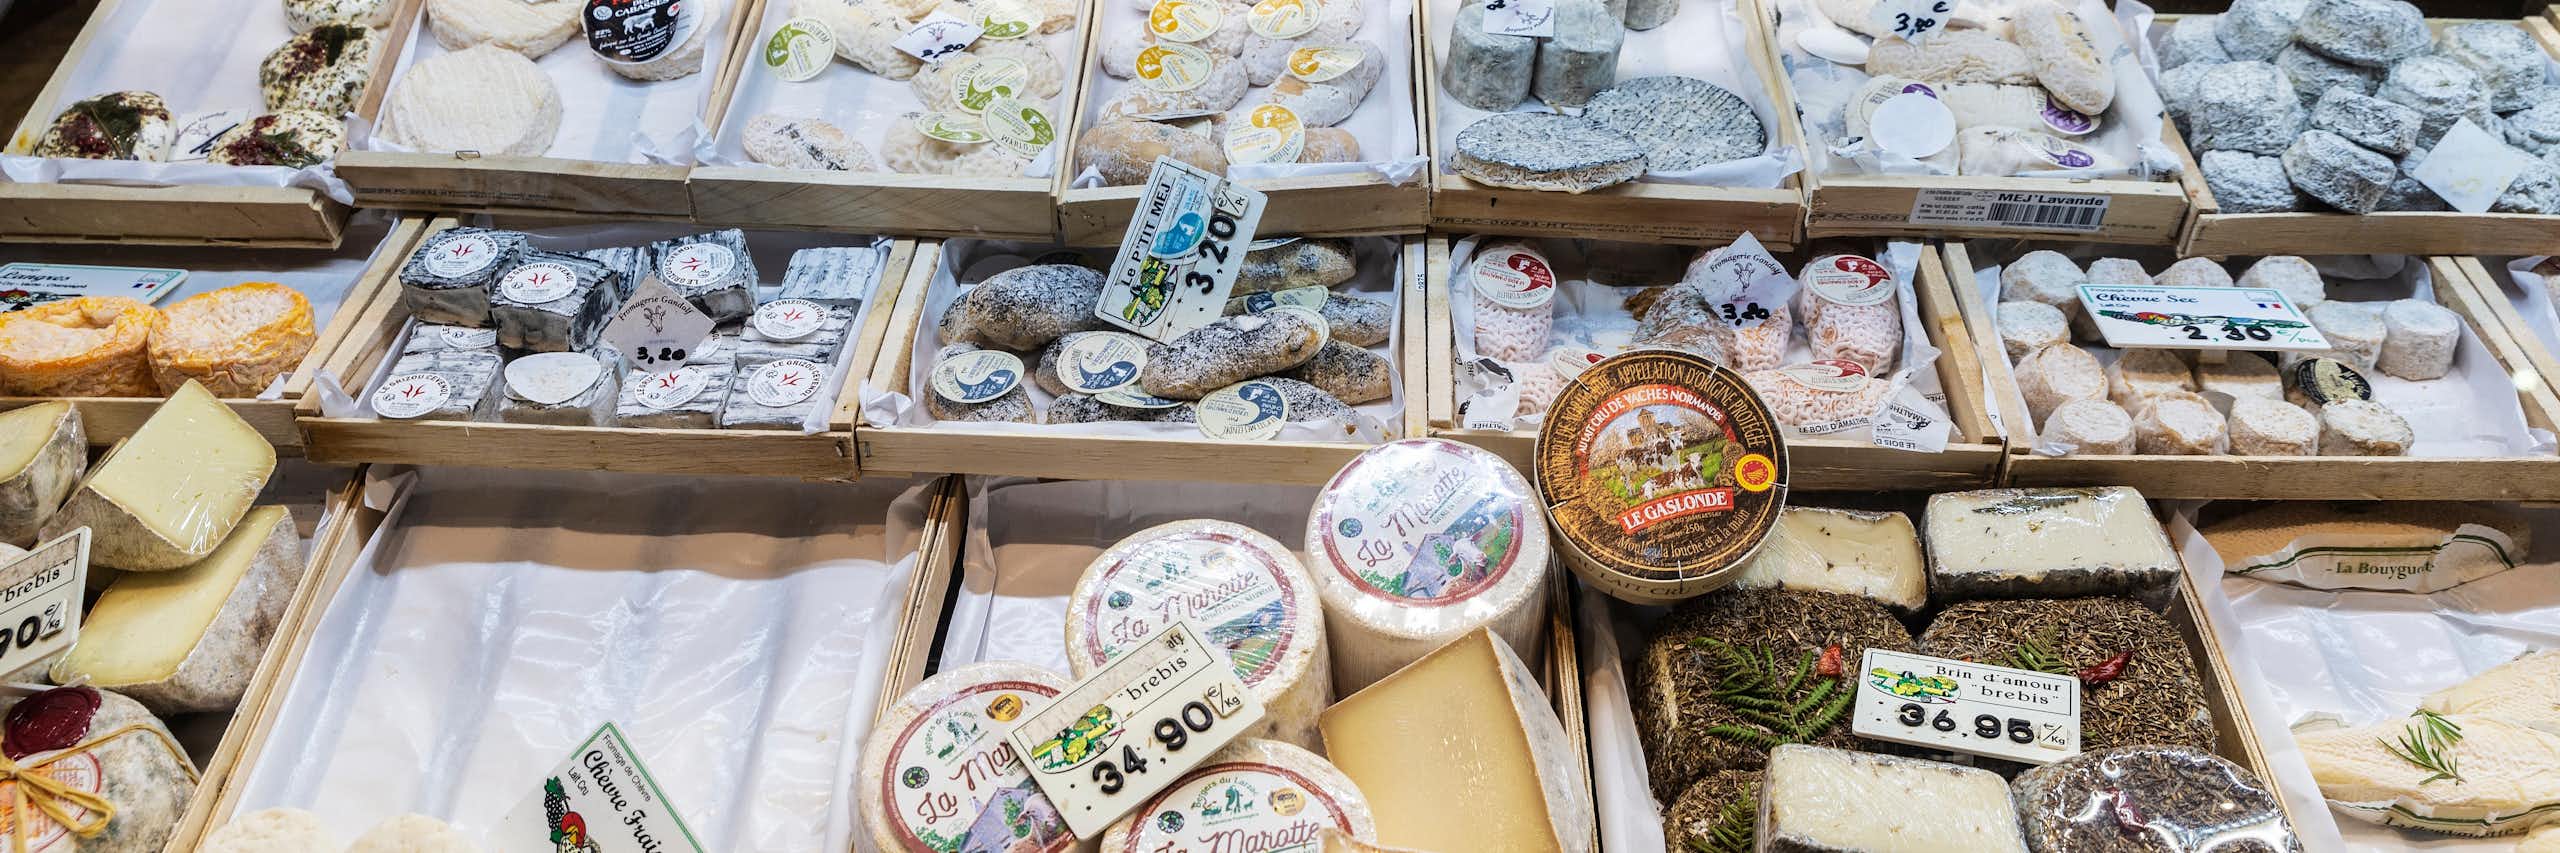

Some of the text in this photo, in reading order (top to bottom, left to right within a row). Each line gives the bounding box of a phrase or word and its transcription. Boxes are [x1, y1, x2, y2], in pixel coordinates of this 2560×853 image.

[1933, 1, 1949, 12] €
[1998, 193, 2104, 206] MEJ'Lavande
[440, 235, 472, 246] GRIZOU
[1121, 183, 1171, 287] Le P'TIT MEJ
[513, 263, 546, 275] GRIZOU
[1710, 252, 1752, 273] Fromagerie
[619, 295, 694, 320] Fromagerie Gandolf
[2096, 293, 2199, 304] Chèvre Sec
[786, 360, 816, 370] GRIZOU
[379, 386, 390, 394] LE
[389, 375, 424, 386] GRIZOU
[1617, 362, 1683, 384] APPELLATION
[1687, 367, 1736, 406] D'ORIGINE
[1729, 396, 1767, 448] PROTÉGÉE
[1580, 389, 1723, 454] AU LAIT CRU DE VACHES NORMANDES
[1810, 425, 1829, 433] BOIS
[1622, 507, 1645, 529] LE
[1644, 491, 1727, 520] GASLONDE
[1671, 538, 1704, 558] louche
[1705, 535, 1715, 547] et
[1719, 525, 1730, 538] la
[1728, 508, 1750, 532] main
[1358, 539, 1393, 567] La
[2336, 562, 2352, 574] La
[1936, 665, 2062, 693] Brin d'amour
[1899, 702, 2035, 744] 36,95
[1092, 701, 1214, 795] 34,90
[568, 766, 589, 796] Lait Cru
[583, 750, 627, 812] Chèvre
[603, 734, 652, 802] Fromage de Chèvre
[917, 792, 958, 824] La
